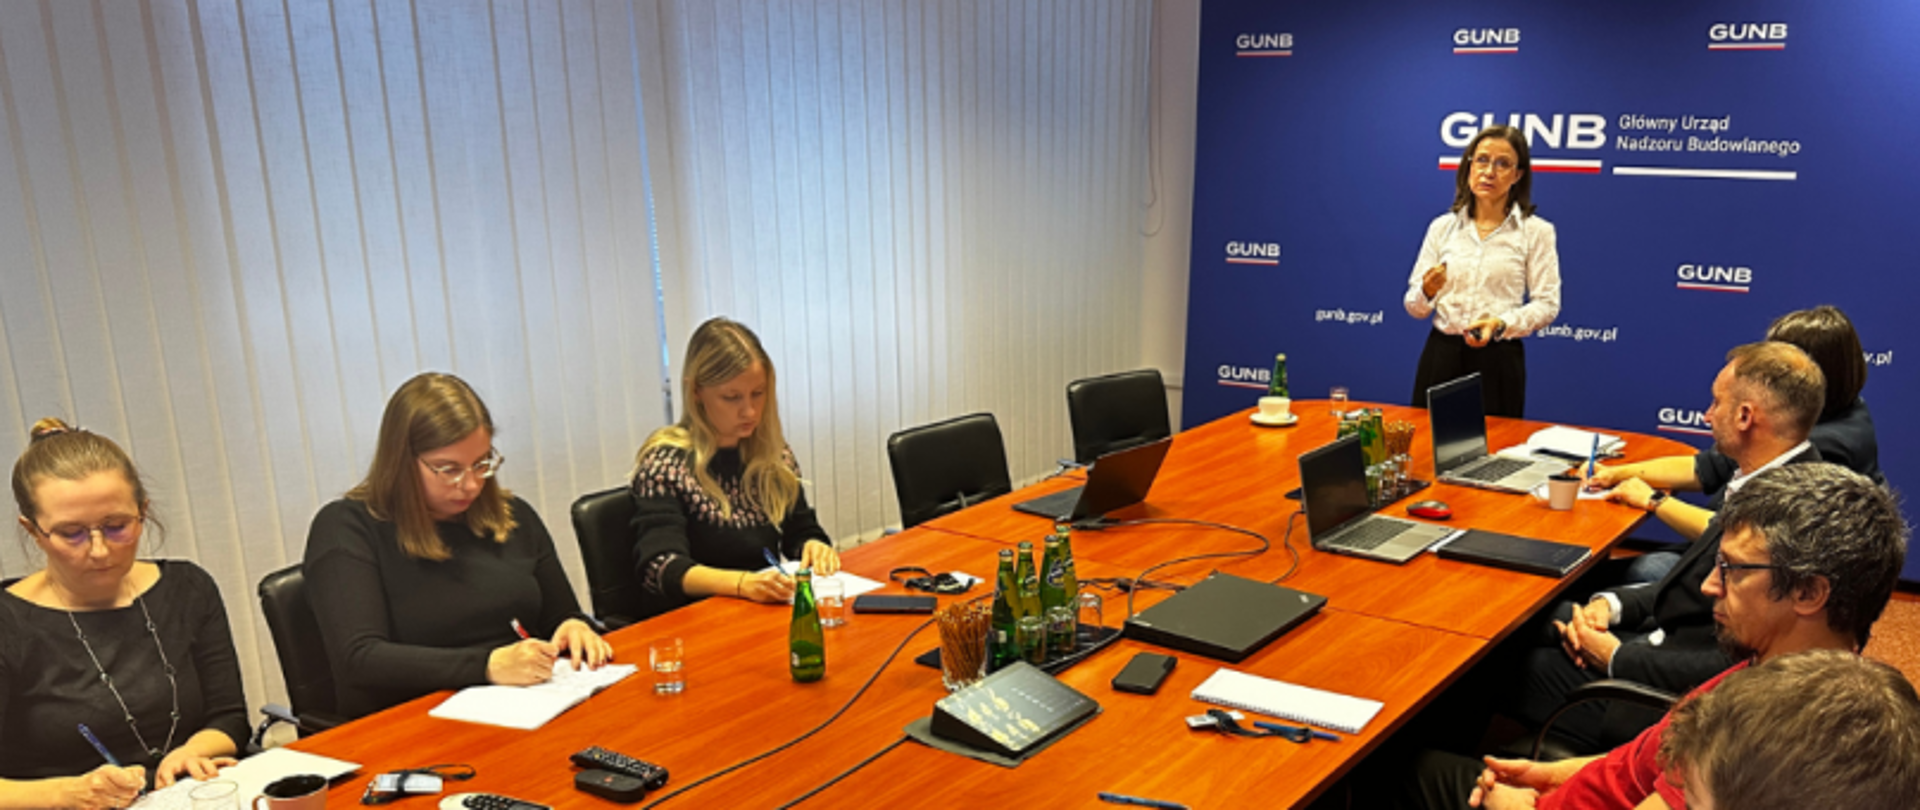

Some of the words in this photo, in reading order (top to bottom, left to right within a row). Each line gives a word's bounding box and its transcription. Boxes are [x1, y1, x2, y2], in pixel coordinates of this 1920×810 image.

[1236, 33, 1294, 49] GUNB
[1453, 28, 1520, 45] GUNB
[1709, 23, 1788, 41] GUNB
[1681, 115, 1731, 134] Urząd
[1615, 135, 1683, 151] Nadzoru
[1687, 136, 1801, 157] Budowlanego
[1226, 241, 1281, 257] GUNB
[1677, 264, 1752, 283] GUNB
[1315, 308, 1384, 325] gunb.gov.pl
[1217, 364, 1271, 382] GUNB
